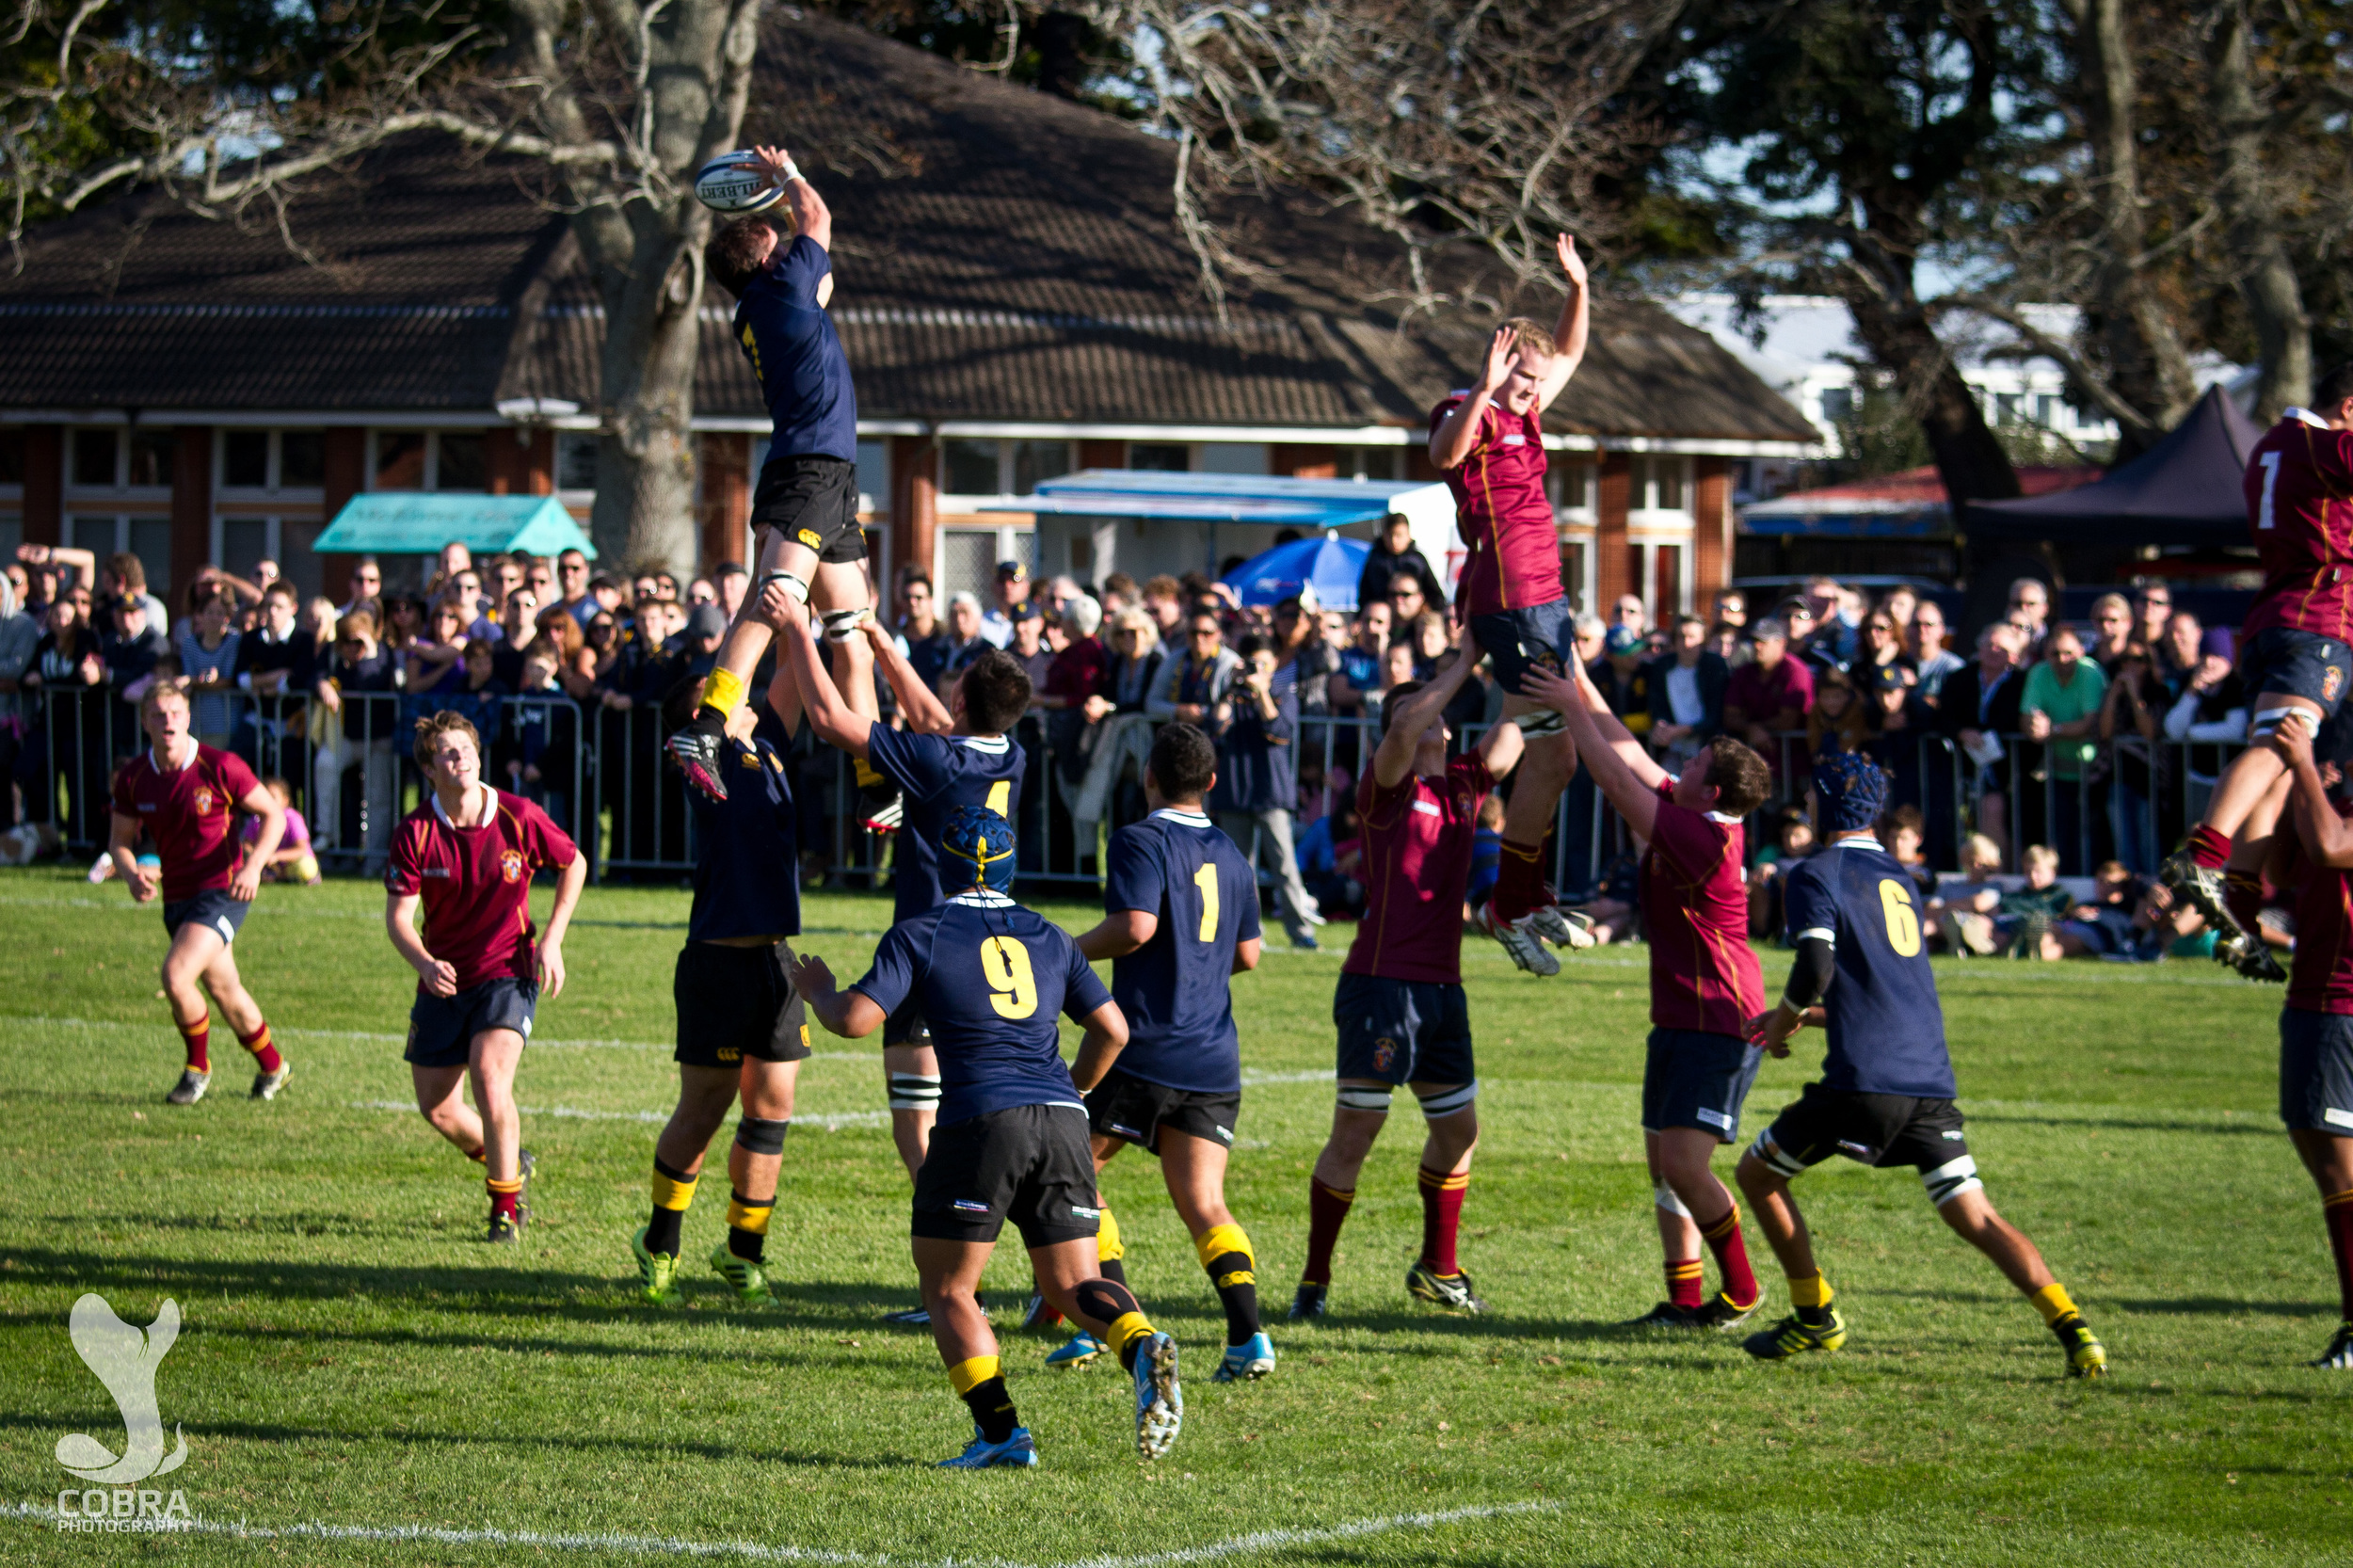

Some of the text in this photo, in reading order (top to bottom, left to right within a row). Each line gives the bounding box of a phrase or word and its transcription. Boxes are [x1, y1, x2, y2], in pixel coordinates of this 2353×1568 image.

[700, 182, 761, 200] ILBERT
[2258, 451, 2281, 529] 1
[1193, 863, 1220, 942] 1
[1879, 878, 1921, 958] 6
[980, 936, 1038, 1019] 9
